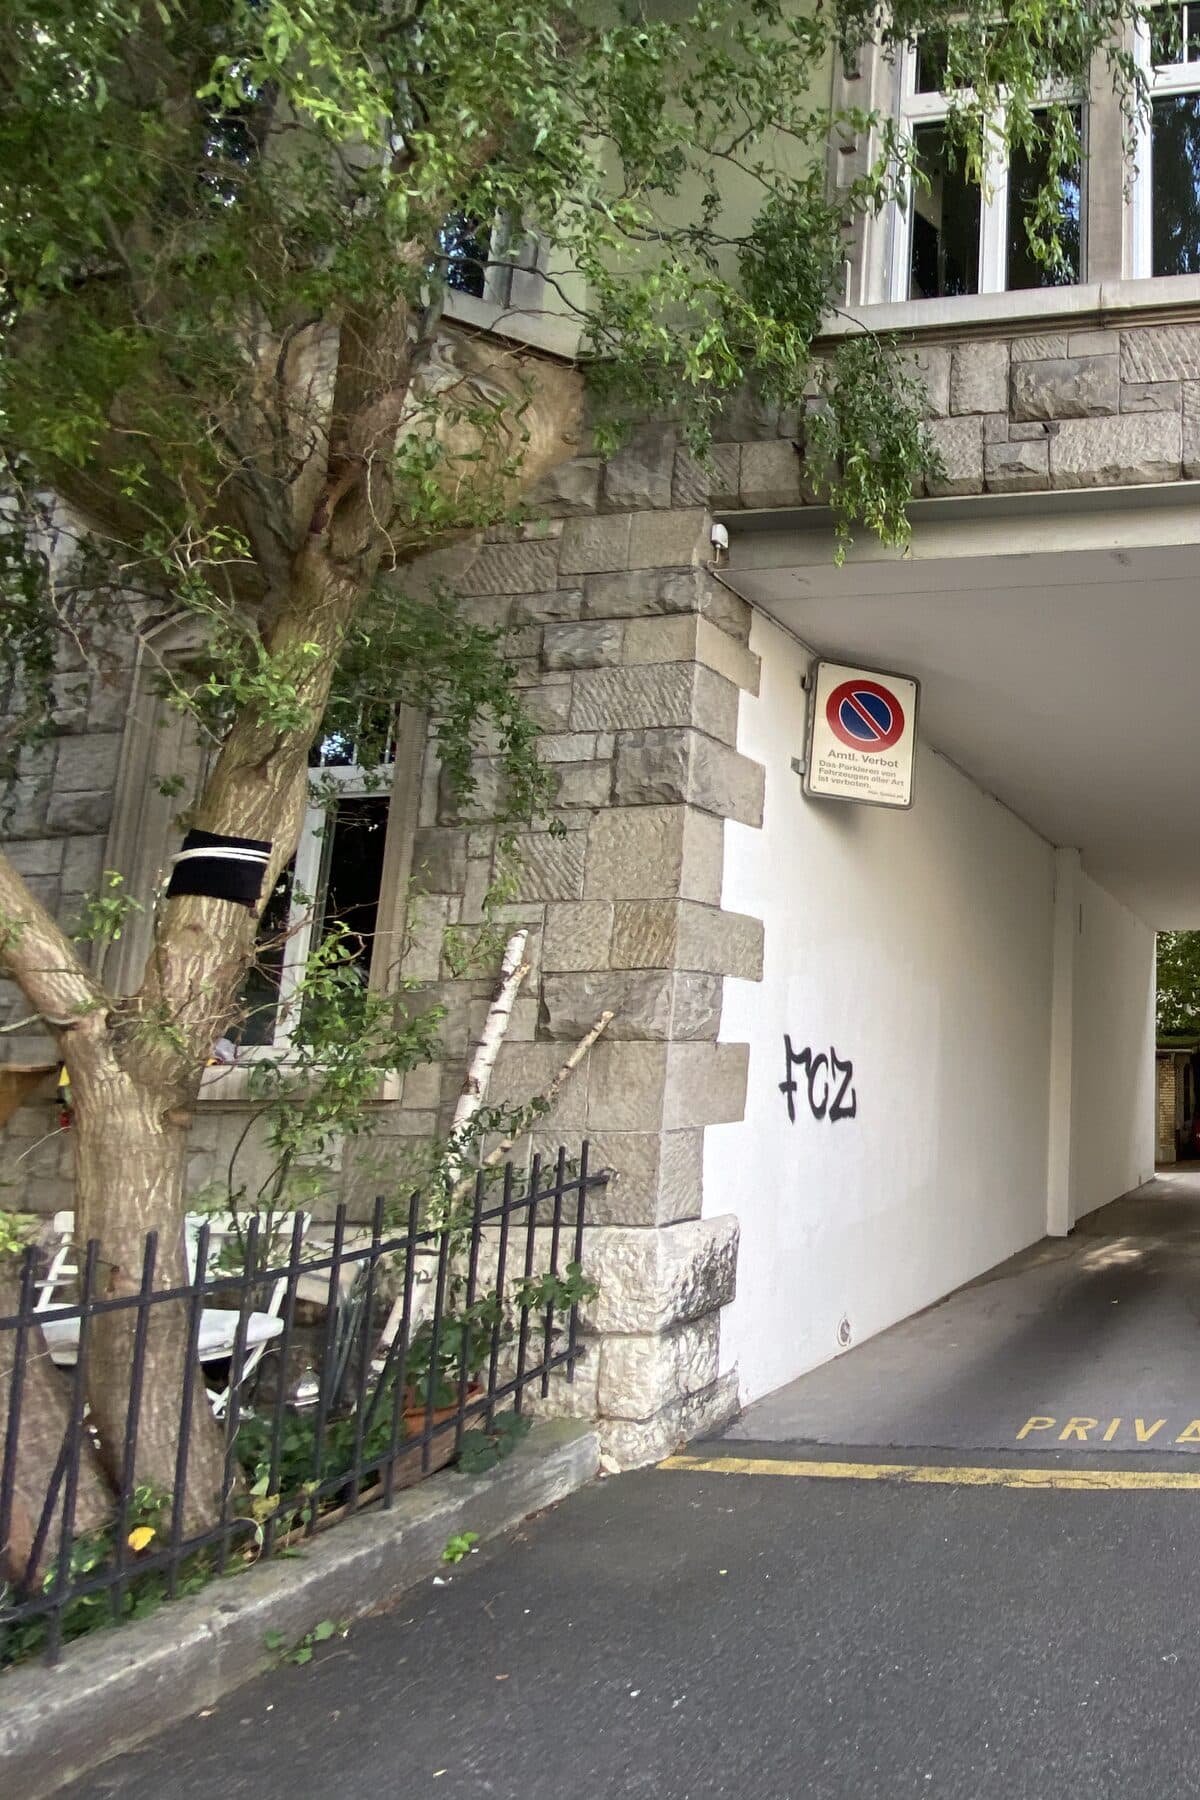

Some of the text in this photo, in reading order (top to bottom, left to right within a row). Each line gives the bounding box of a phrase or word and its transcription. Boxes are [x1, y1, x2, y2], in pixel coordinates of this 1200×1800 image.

[819, 759, 836, 769] Das
[838, 762, 880, 775] Parkieren
[828, 749, 899, 768] Amtl. Verbot
[818, 767, 904, 787] Fahrzeugen aller Art
[831, 777, 872, 789] verboten.
